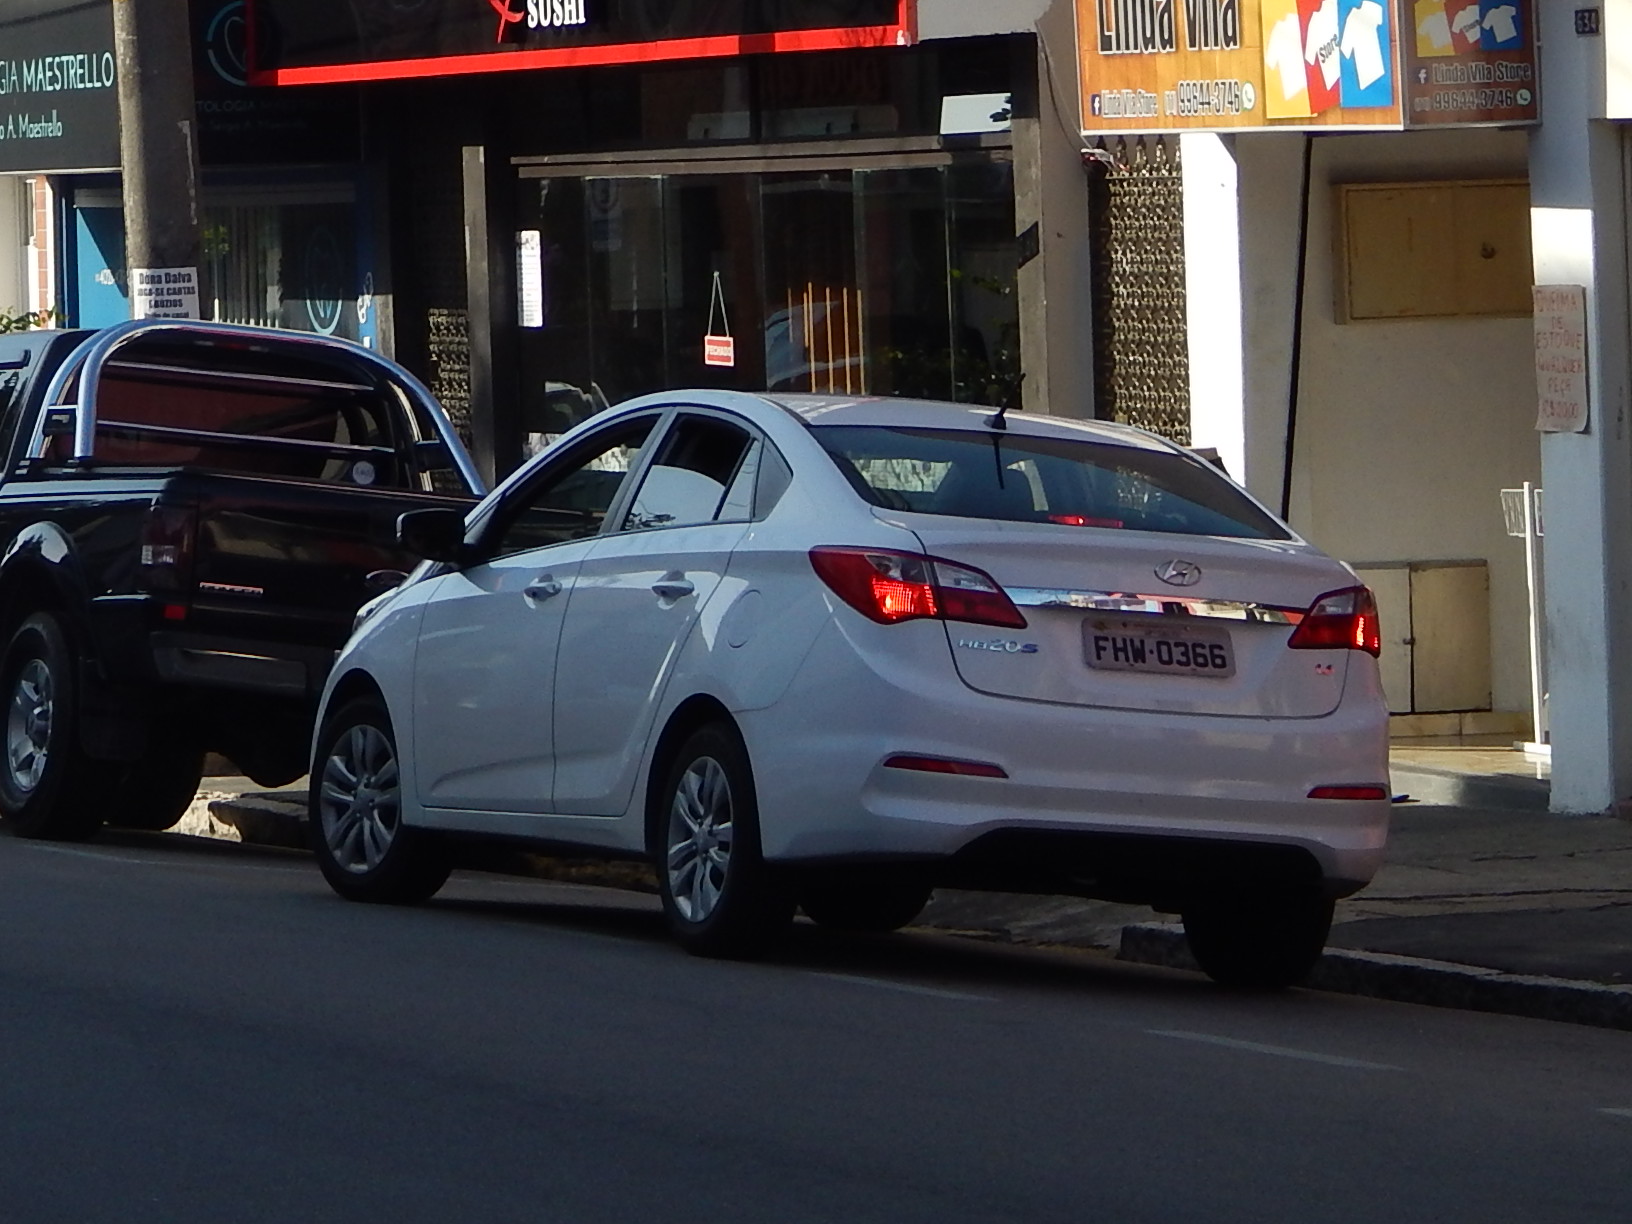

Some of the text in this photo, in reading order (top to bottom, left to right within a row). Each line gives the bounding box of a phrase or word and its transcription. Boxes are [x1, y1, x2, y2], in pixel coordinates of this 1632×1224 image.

[1576, 12, 1599, 30] 634
[1318, 34, 1339, 64] Store
[22, 51, 114, 93] MAESTRELLO
[1432, 60, 1531, 85] Linda Vila Store
[1434, 88, 1513, 111] 99644-3746
[18, 109, 62, 139] Maestrello
